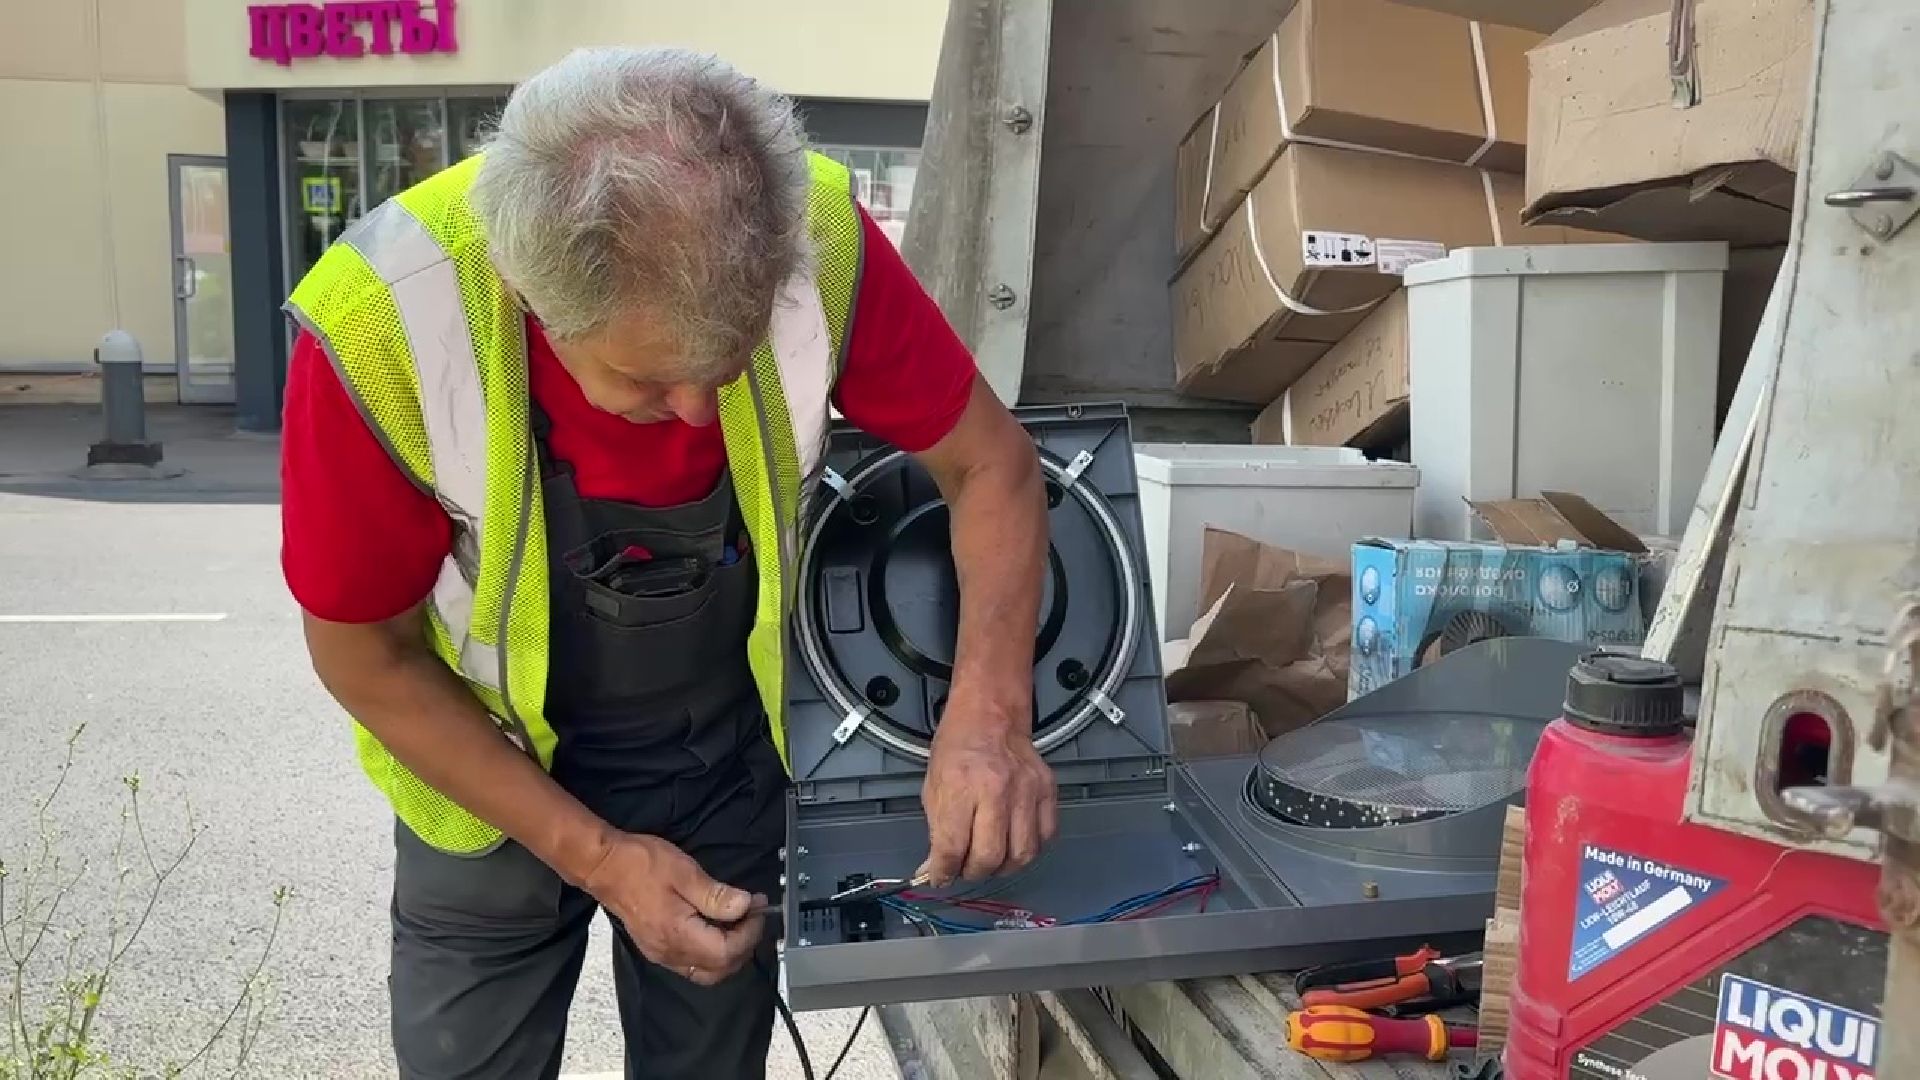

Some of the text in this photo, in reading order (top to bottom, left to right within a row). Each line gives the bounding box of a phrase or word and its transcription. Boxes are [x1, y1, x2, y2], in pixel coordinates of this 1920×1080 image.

[247, 0, 458, 66] ЦВЕТЫ
[1584, 845, 1712, 893] Made in Germany
[1726, 981, 1877, 1066] LIQUI
